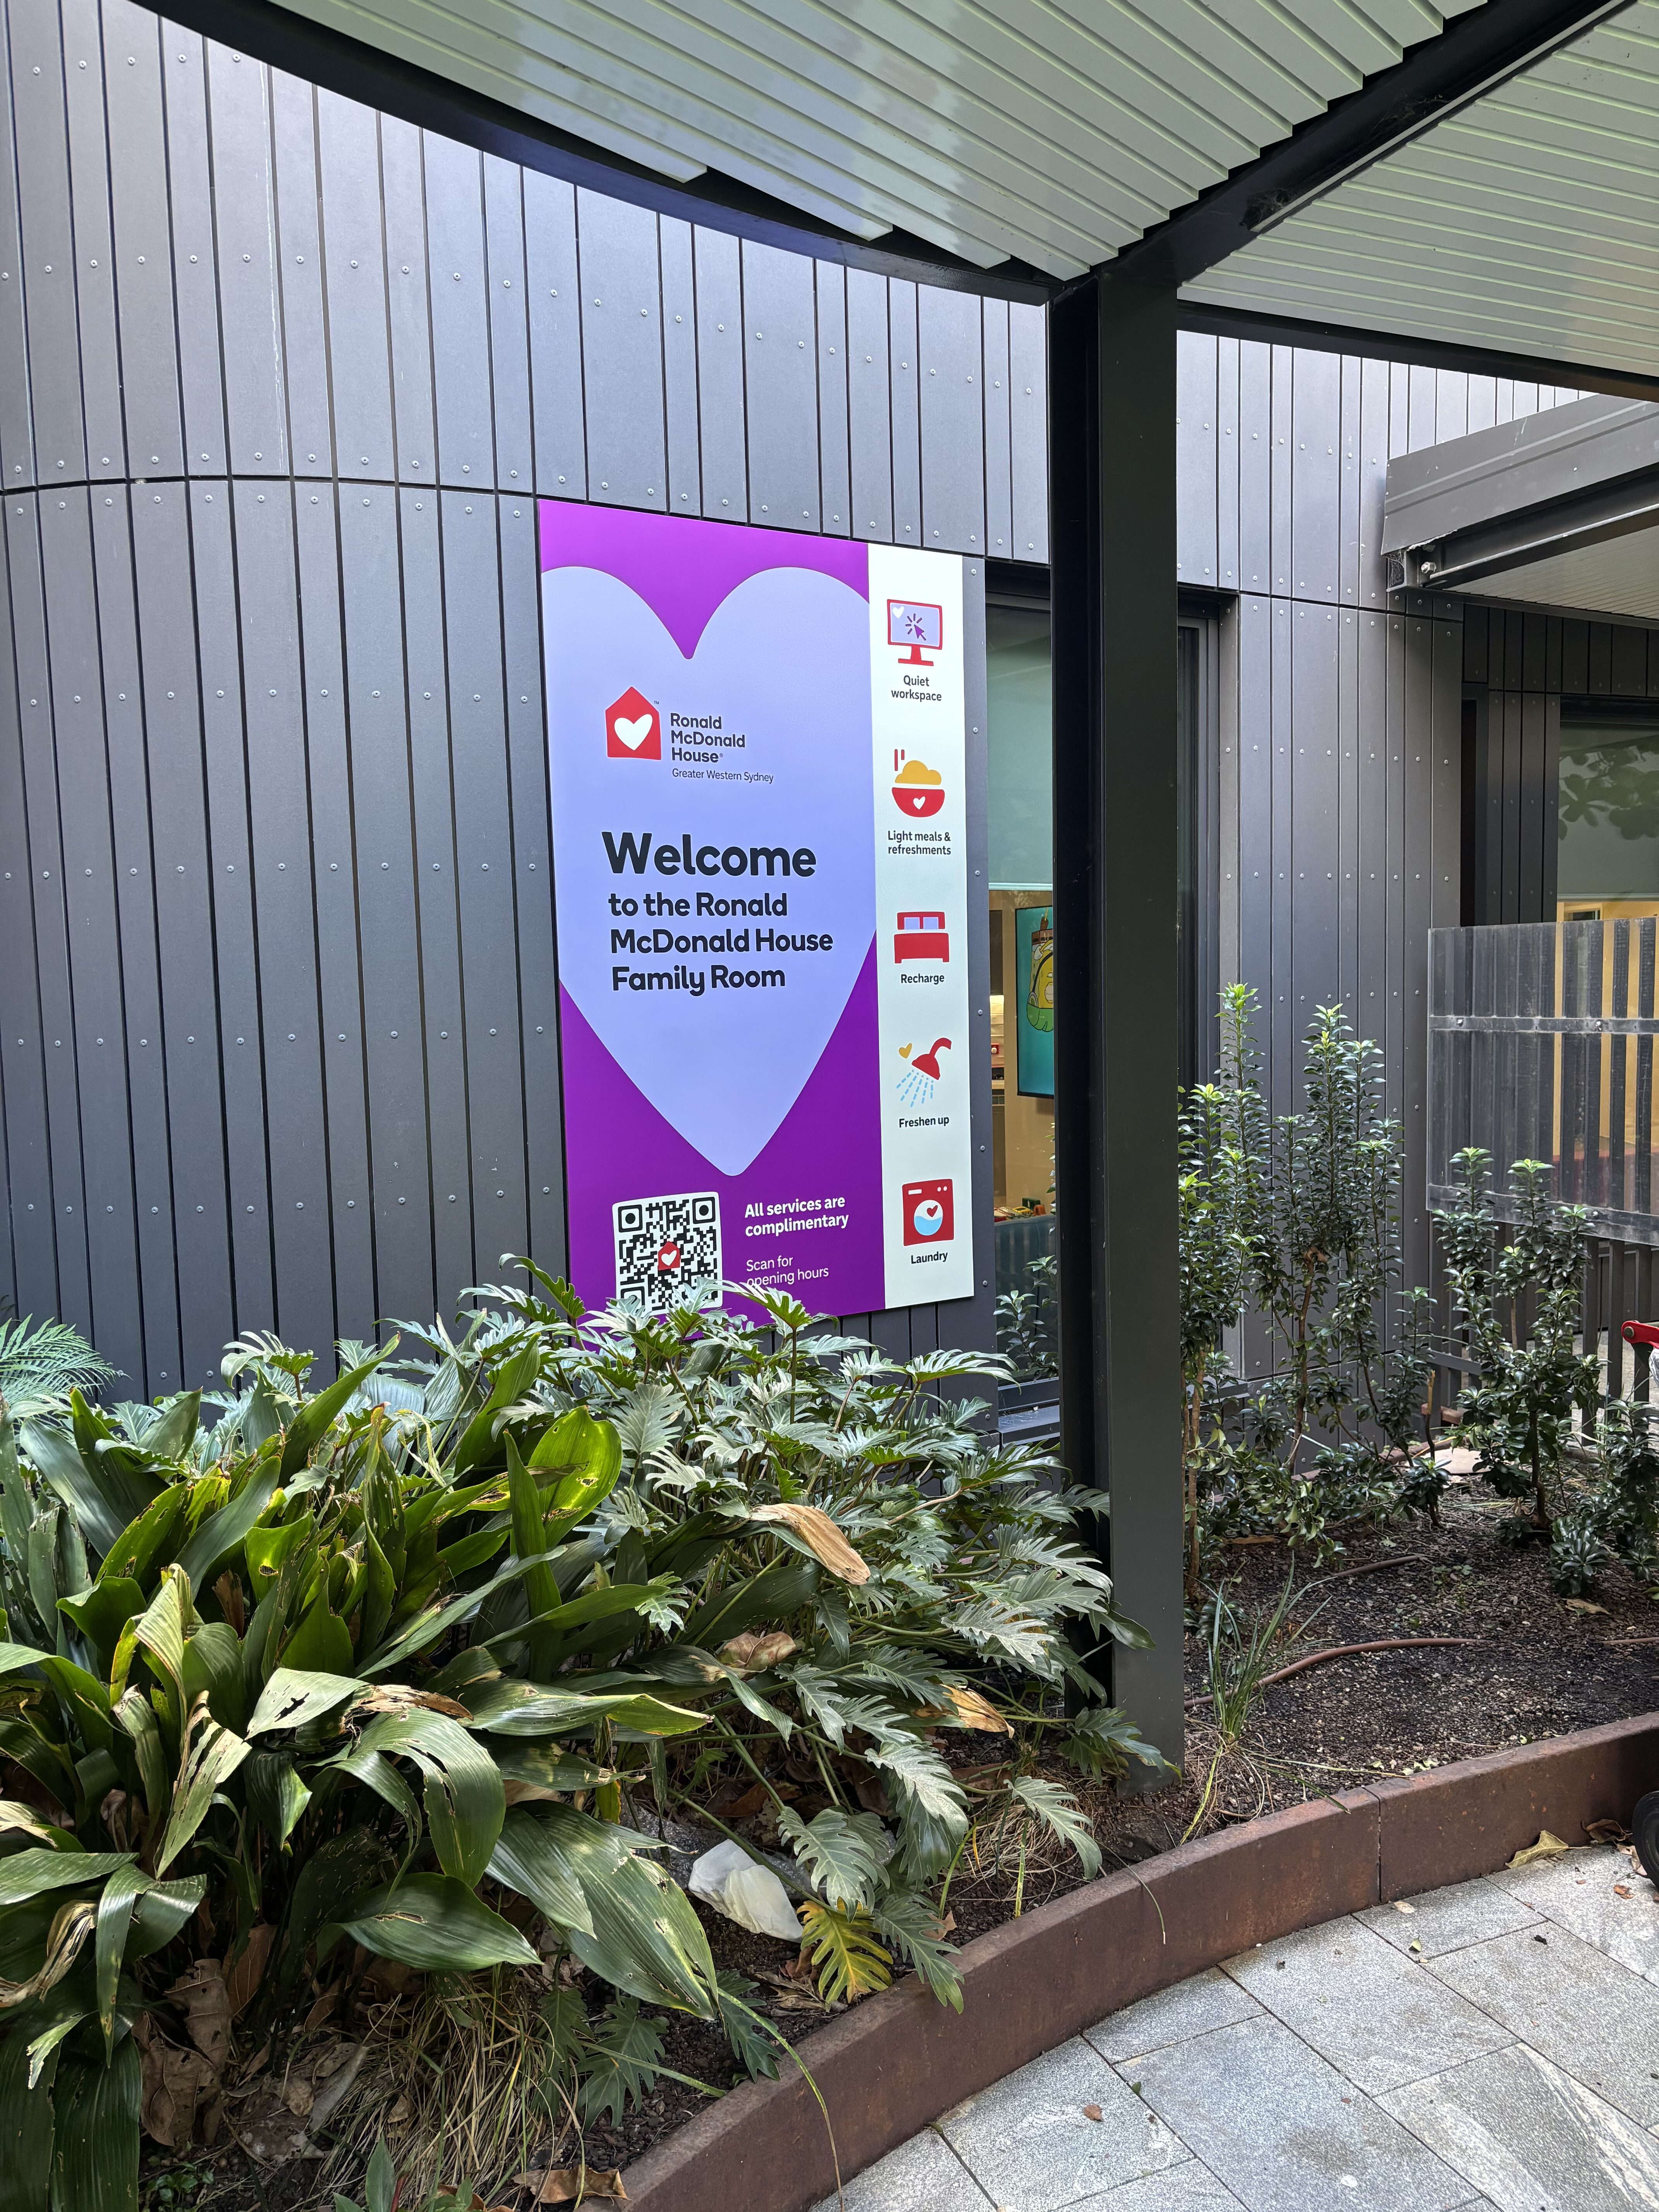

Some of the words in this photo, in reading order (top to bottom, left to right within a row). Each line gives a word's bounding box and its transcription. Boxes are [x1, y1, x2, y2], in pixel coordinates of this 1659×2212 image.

[903, 675, 930, 687] Quiet
[891, 689, 942, 702] workspace
[670, 713, 722, 730] Ronald
[671, 730, 745, 748] McDonald
[672, 768, 704, 778] Greater
[706, 770, 742, 780] Western
[744, 771, 774, 784] Sydney
[888, 830, 913, 843] Light
[915, 831, 942, 842] meals
[944, 832, 951, 842] &
[601, 831, 816, 877] Welcome
[888, 844, 951, 855] refreshments
[608, 893, 639, 916] to
[643, 892, 690, 917] the
[696, 892, 787, 917] Ronald
[611, 928, 750, 953] McDonald
[756, 928, 833, 952] House
[612, 965, 705, 996] Family
[711, 965, 785, 988] Room
[901, 973, 945, 985] Recharge
[899, 1116, 936, 1128] Freshen
[938, 1117, 949, 1127] up
[745, 1202, 764, 1218] All
[767, 1198, 822, 1216] services
[824, 1197, 845, 1209] are
[745, 1214, 849, 1237] complimentary
[746, 1259, 775, 1272] Scan
[777, 1255, 793, 1267] for
[911, 1251, 948, 1264] Laundry
[747, 1271, 794, 1286] opening
[797, 1267, 829, 1280] hours
